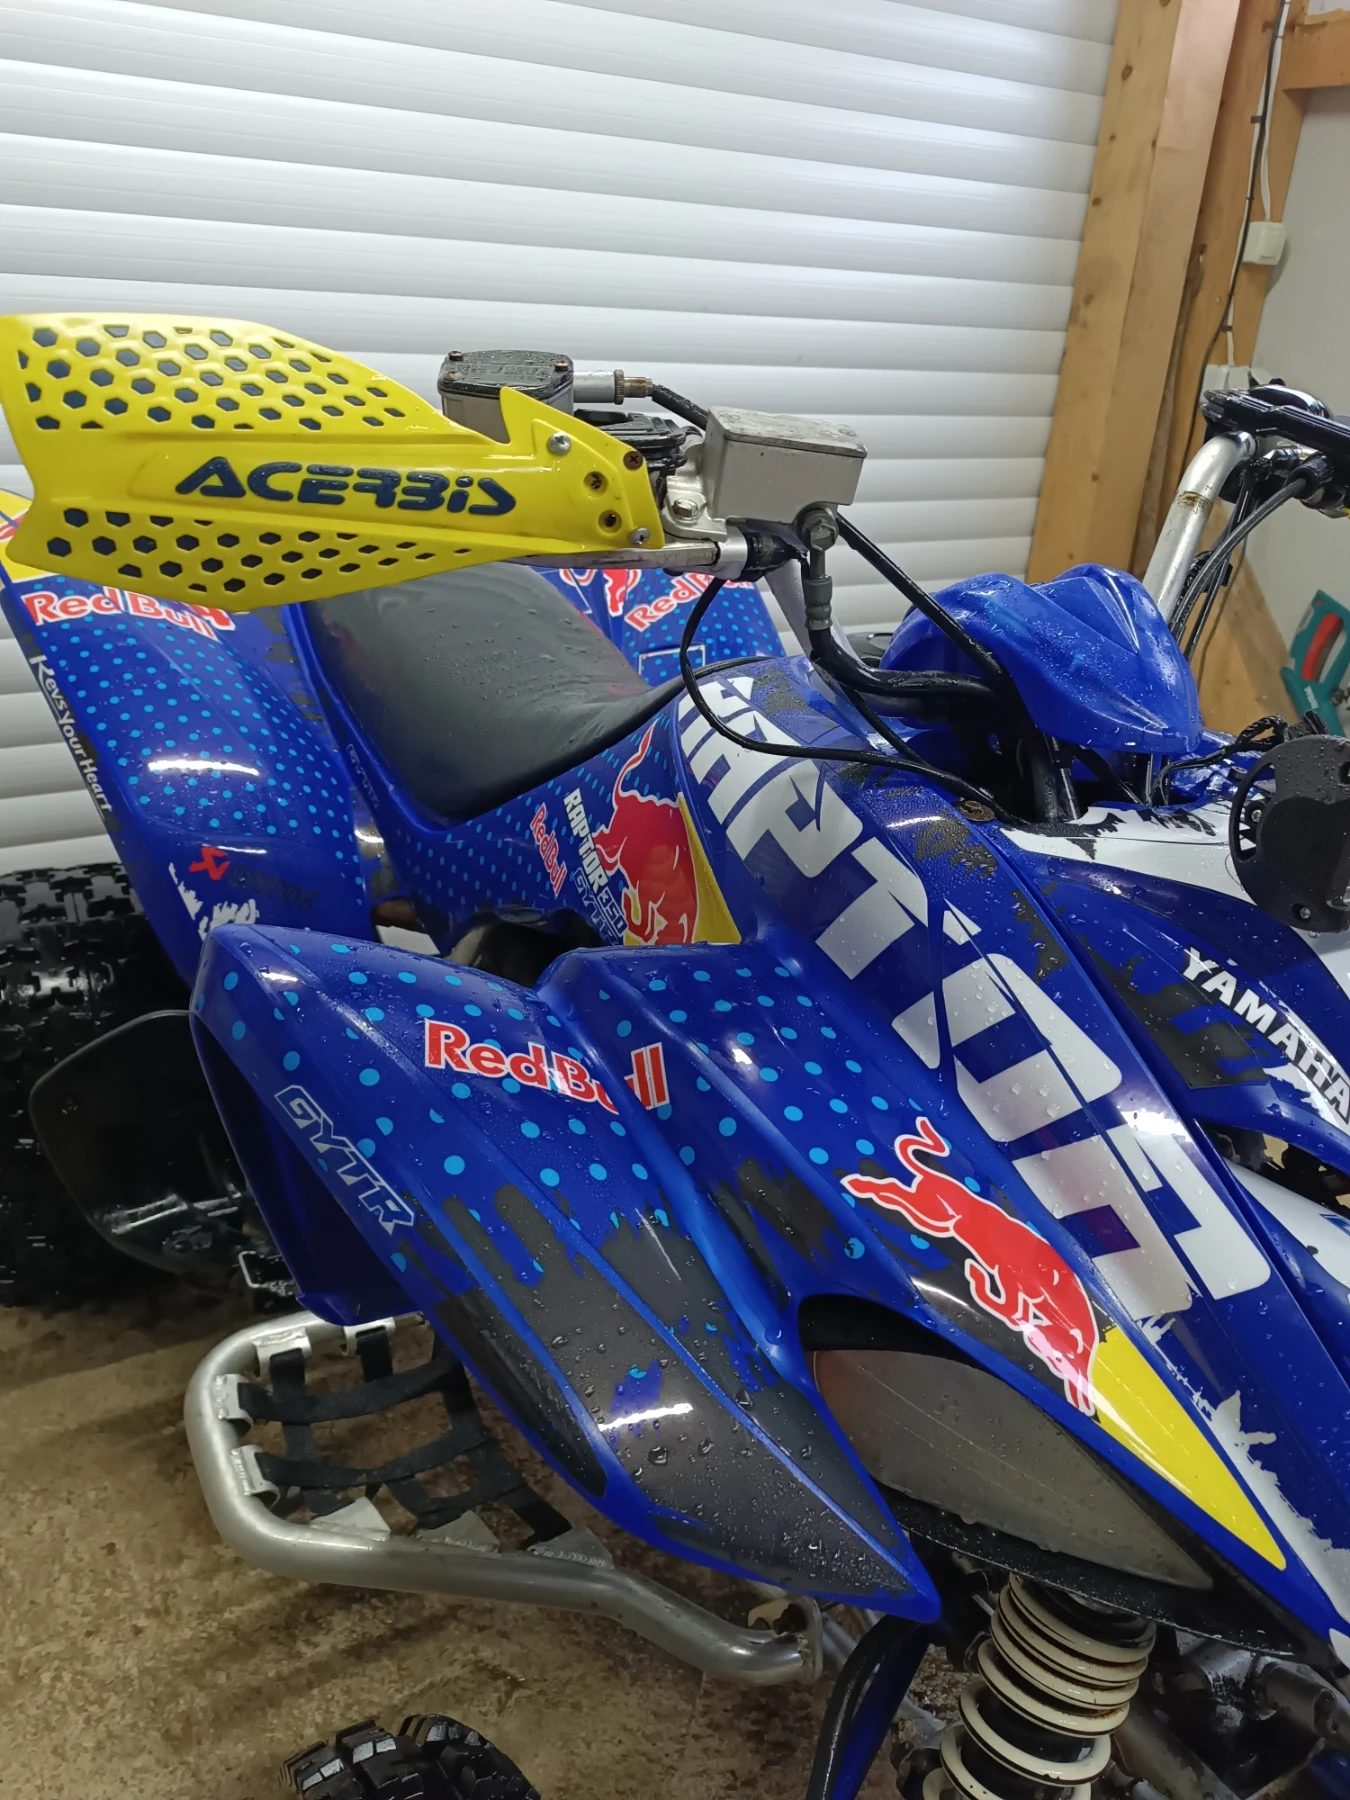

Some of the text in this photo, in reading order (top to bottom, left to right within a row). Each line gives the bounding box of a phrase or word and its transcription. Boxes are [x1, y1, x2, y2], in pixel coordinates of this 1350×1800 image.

[20, 585, 124, 626] Red
[624, 578, 703, 632] Red
[58, 708, 88, 760] Your
[80, 757, 113, 813] Heart
[530, 802, 568, 898] Red Bull
[563, 787, 629, 938] RAPTOR 350
[424, 1018, 552, 1090] Red
[1182, 946, 1350, 1126] YAMAHA
[274, 1084, 415, 1236] GYTR
